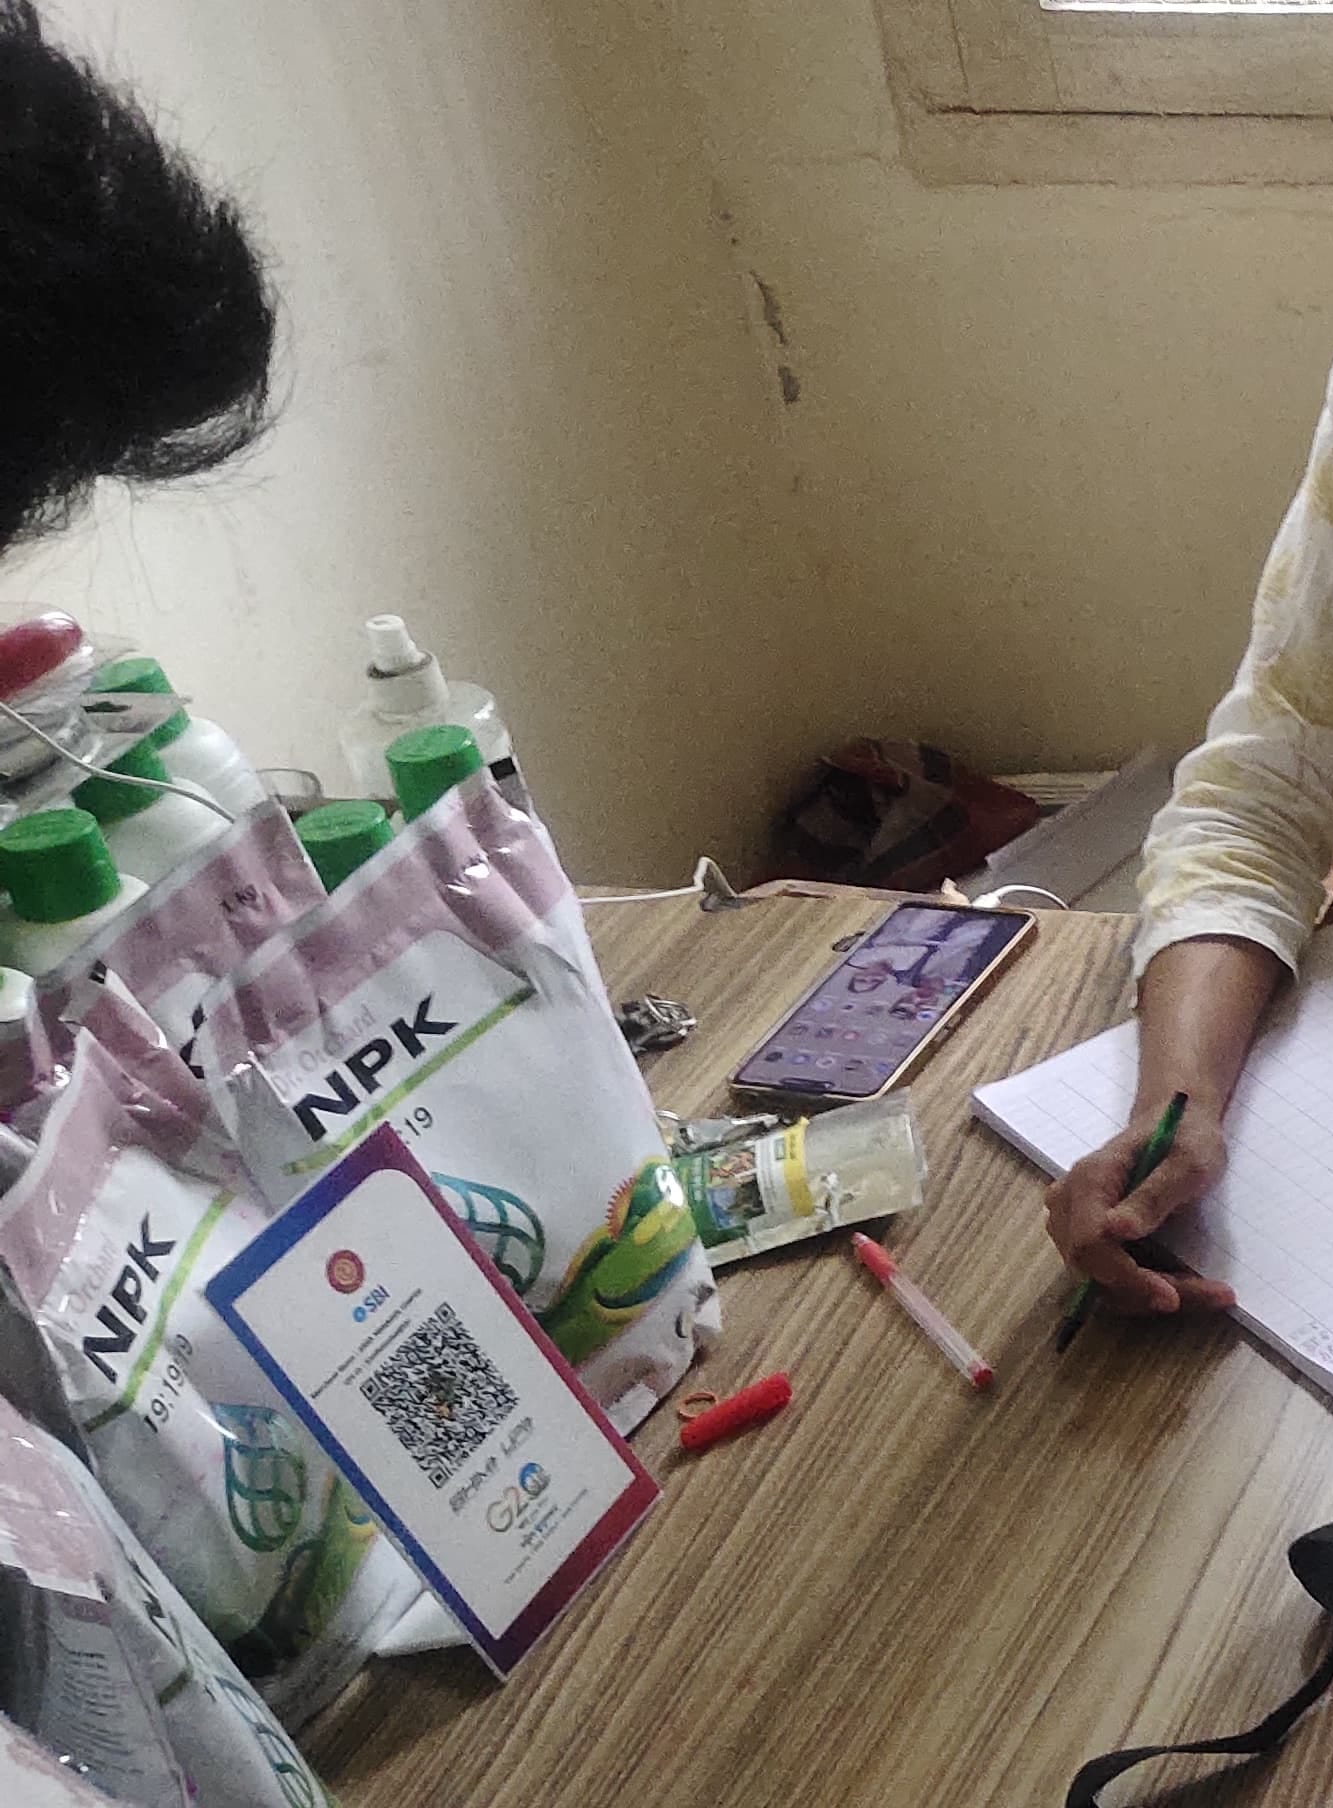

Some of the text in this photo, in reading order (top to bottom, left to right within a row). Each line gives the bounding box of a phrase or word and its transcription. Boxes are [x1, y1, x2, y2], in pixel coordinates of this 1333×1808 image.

[291, 991, 459, 1143] NPK
[82, 1212, 177, 1384] NPK
[363, 1283, 391, 1313] SBI
[486, 1461, 552, 1533] G20
